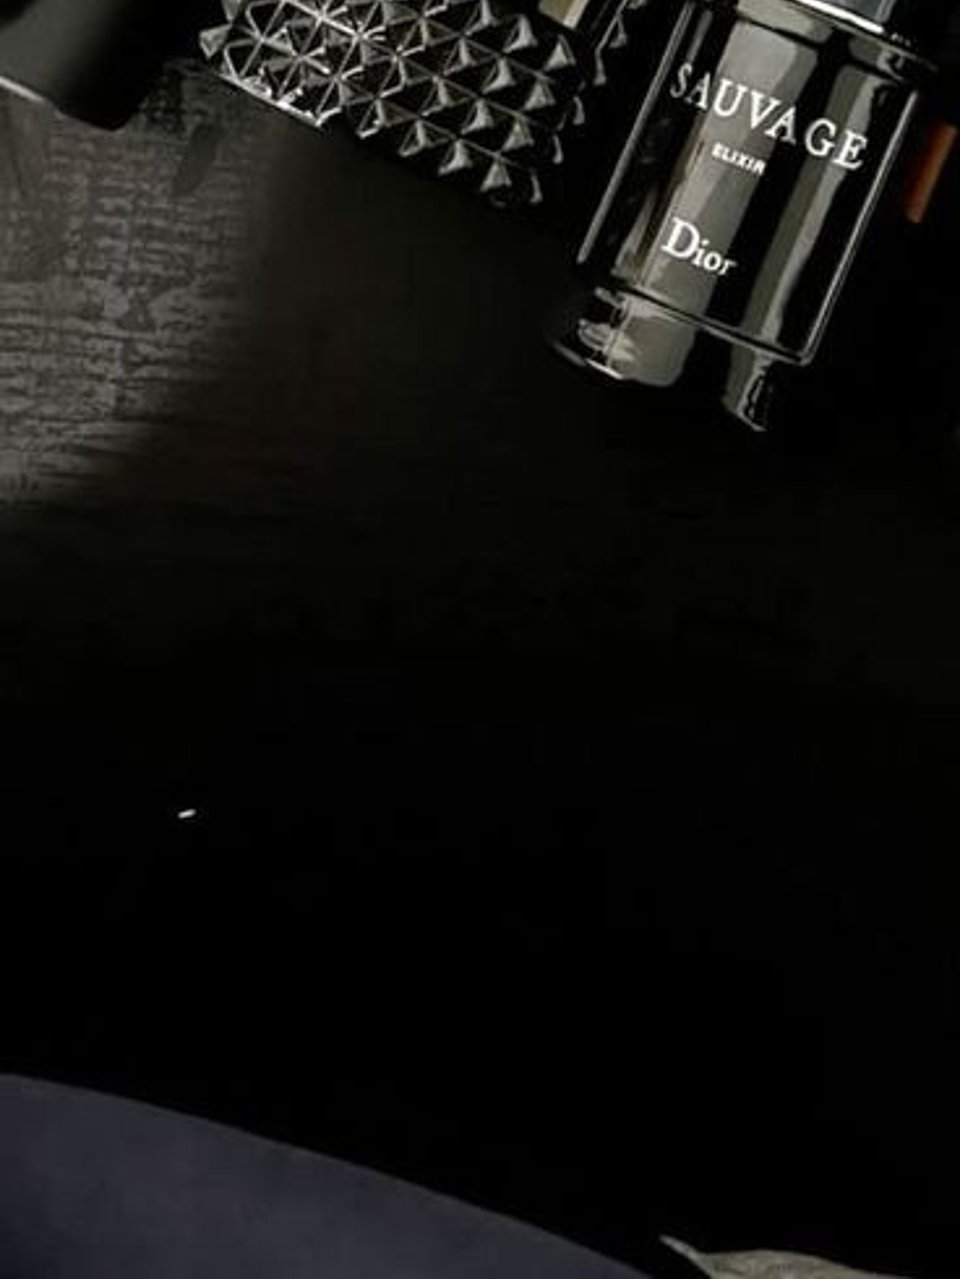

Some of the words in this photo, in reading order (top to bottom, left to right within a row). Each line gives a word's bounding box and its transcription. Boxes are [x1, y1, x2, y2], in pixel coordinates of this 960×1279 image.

[669, 62, 868, 170] SAUVAGE
[711, 142, 767, 176] ELIXIR
[661, 217, 738, 276] Dior
